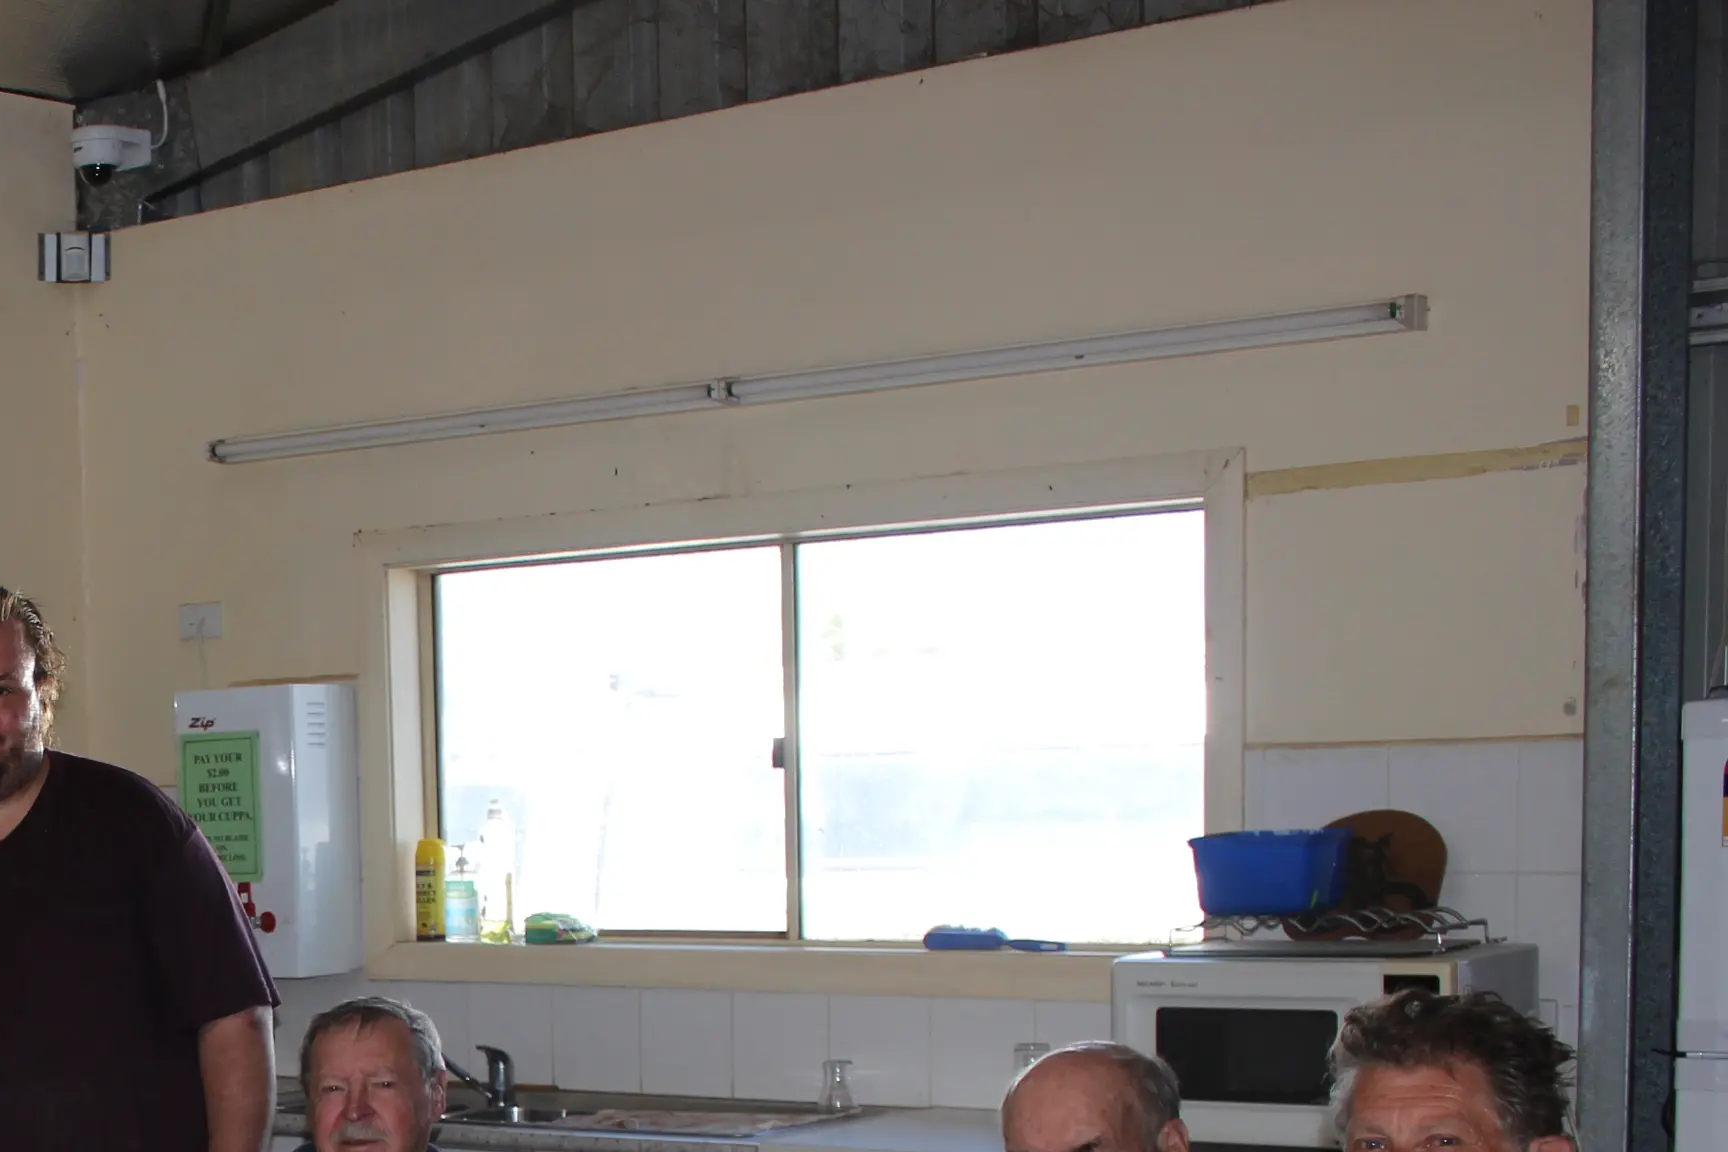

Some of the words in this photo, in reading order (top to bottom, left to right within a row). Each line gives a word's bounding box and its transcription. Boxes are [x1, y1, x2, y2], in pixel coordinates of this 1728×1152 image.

[189, 717, 215, 730] Zip
[194, 755, 210, 764] PAY
[214, 753, 242, 764] YOUR
[198, 782, 239, 793] BEFORE
[197, 797, 218, 808] YOU
[221, 796, 241, 806] GET
[194, 812, 216, 822] OUR
[218, 811, 252, 822] CUPPA.
